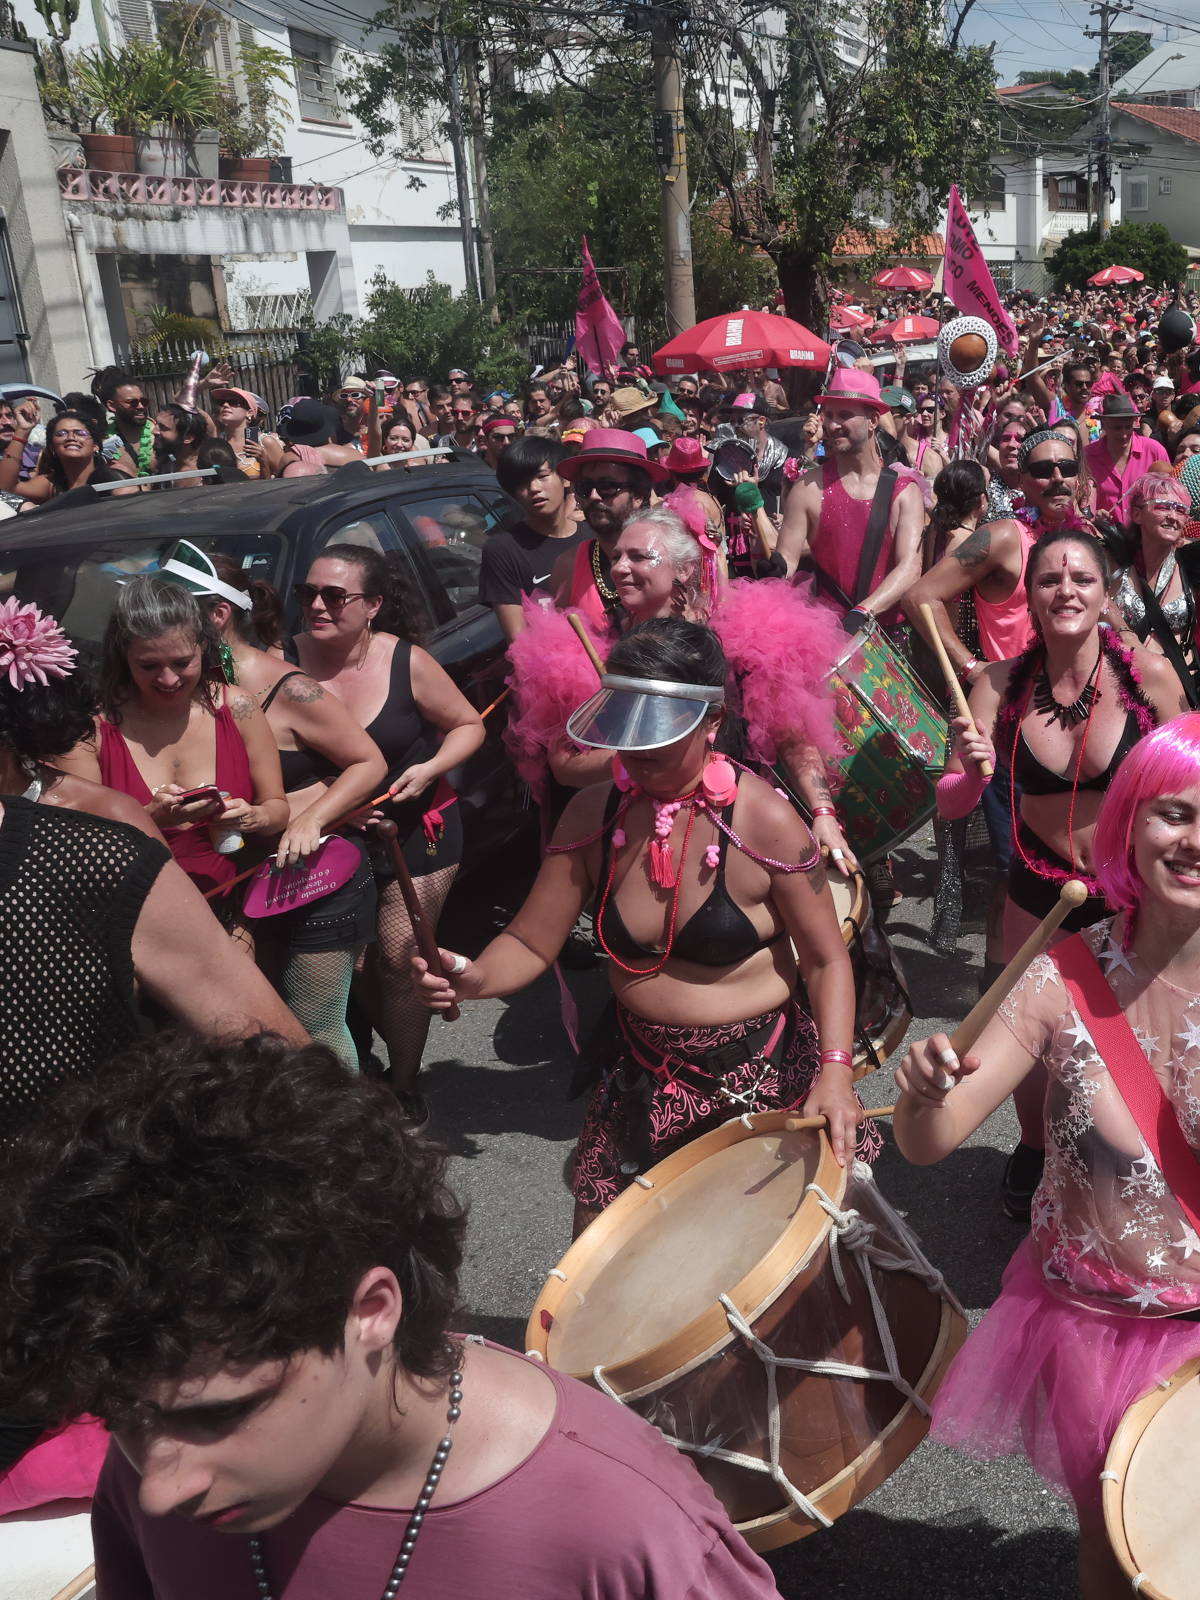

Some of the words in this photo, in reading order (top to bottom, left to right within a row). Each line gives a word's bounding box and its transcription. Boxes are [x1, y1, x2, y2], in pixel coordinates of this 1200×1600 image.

[966, 279, 1015, 346] MENDES
[789, 349, 815, 361] BRAHMA
[301, 883, 329, 900] enredo
[329, 881, 337, 889] O
